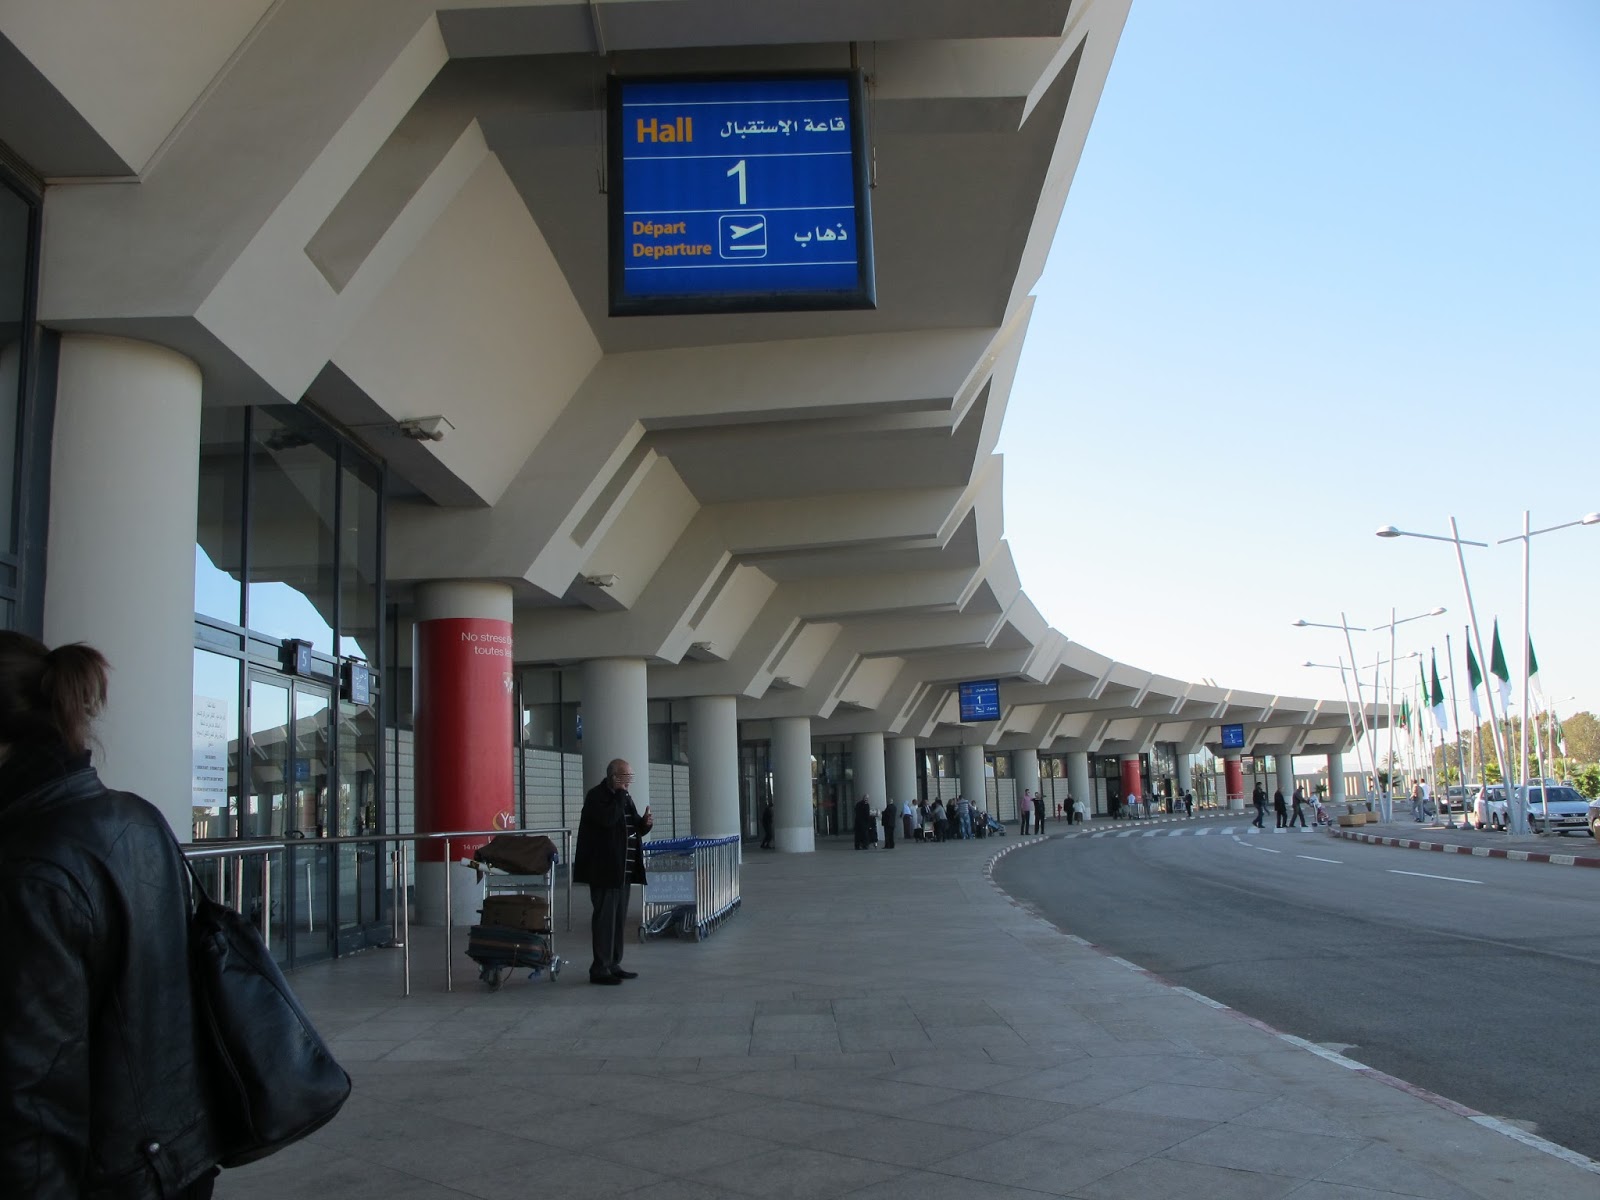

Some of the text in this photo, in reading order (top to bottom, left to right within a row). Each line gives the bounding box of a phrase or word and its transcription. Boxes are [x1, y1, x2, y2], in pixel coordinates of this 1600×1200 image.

[636, 116, 693, 143] Hall
[719, 116, 846, 139] قاعة الإستقبال
[727, 159, 748, 205] 1
[632, 221, 686, 237] Départ
[794, 223, 848, 248] ذهاب
[632, 243, 712, 260] Departure
[461, 632, 478, 642] No
[480, 633, 507, 644] stress
[302, 650, 307, 667] 5
[474, 645, 504, 657] toutes
[977, 695, 982, 704] 1
